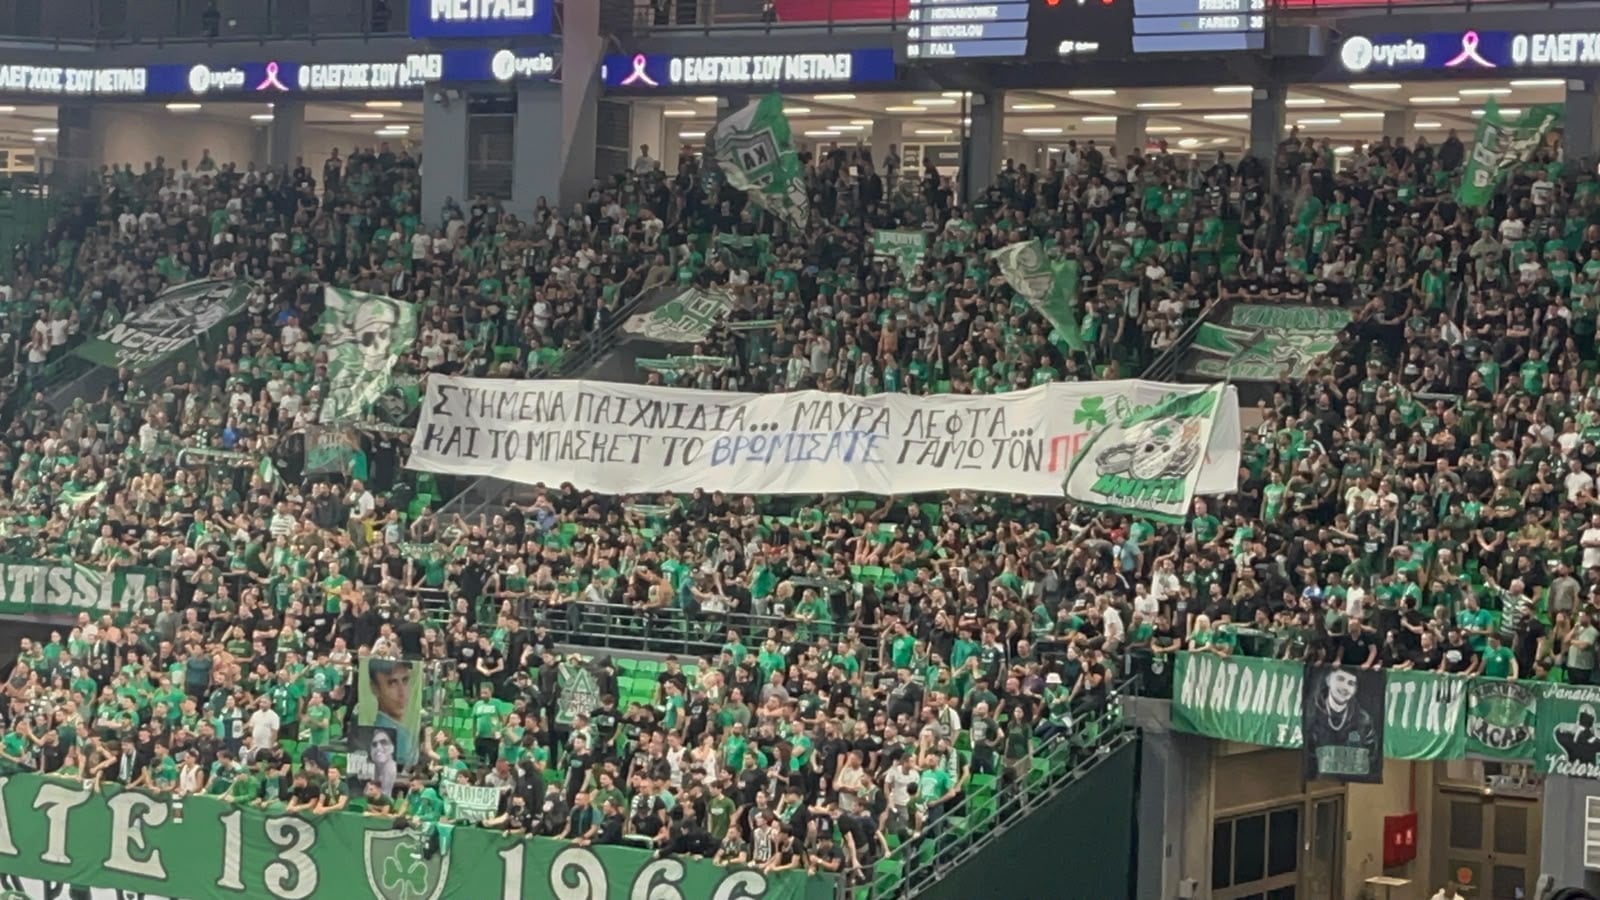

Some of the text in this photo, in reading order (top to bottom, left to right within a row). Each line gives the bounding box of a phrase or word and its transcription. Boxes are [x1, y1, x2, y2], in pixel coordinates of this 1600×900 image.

[684, 56, 751, 82] ΕΛΕΓΧΟΣ
[752, 55, 784, 80] ΣΟΥ
[785, 53, 852, 80] ΜΕΤΡΑΕΙ
[930, 43, 956, 56] FALL
[1512, 34, 1528, 62] Ο
[65, 68, 94, 92] ΣΟΥ
[371, 63, 398, 87] ΣΟΥ
[433, 384, 1034, 442] ΣΤΗΜΕΝΑ ΠΑΙΧΝΙΔΙΑ... ΜΑΥΡΑ ΛΕΦΤΑ...
[423, 423, 482, 458] ΚΑΙ
[488, 428, 521, 461] ΤΟ
[525, 430, 650, 464] ΜΠΑΣΚΕΤ
[662, 434, 705, 467] ΤΟ
[710, 429, 890, 467] ΒΡΩΜΙΣΑΤΕ
[896, 439, 985, 470] ΓΑΜΩ
[991, 437, 1045, 472] ΤΟΝ
[0, 563, 147, 613] TISSIA
[1384, 679, 1465, 736] ΤΤΙΚΗ
[216, 810, 319, 900] 13
